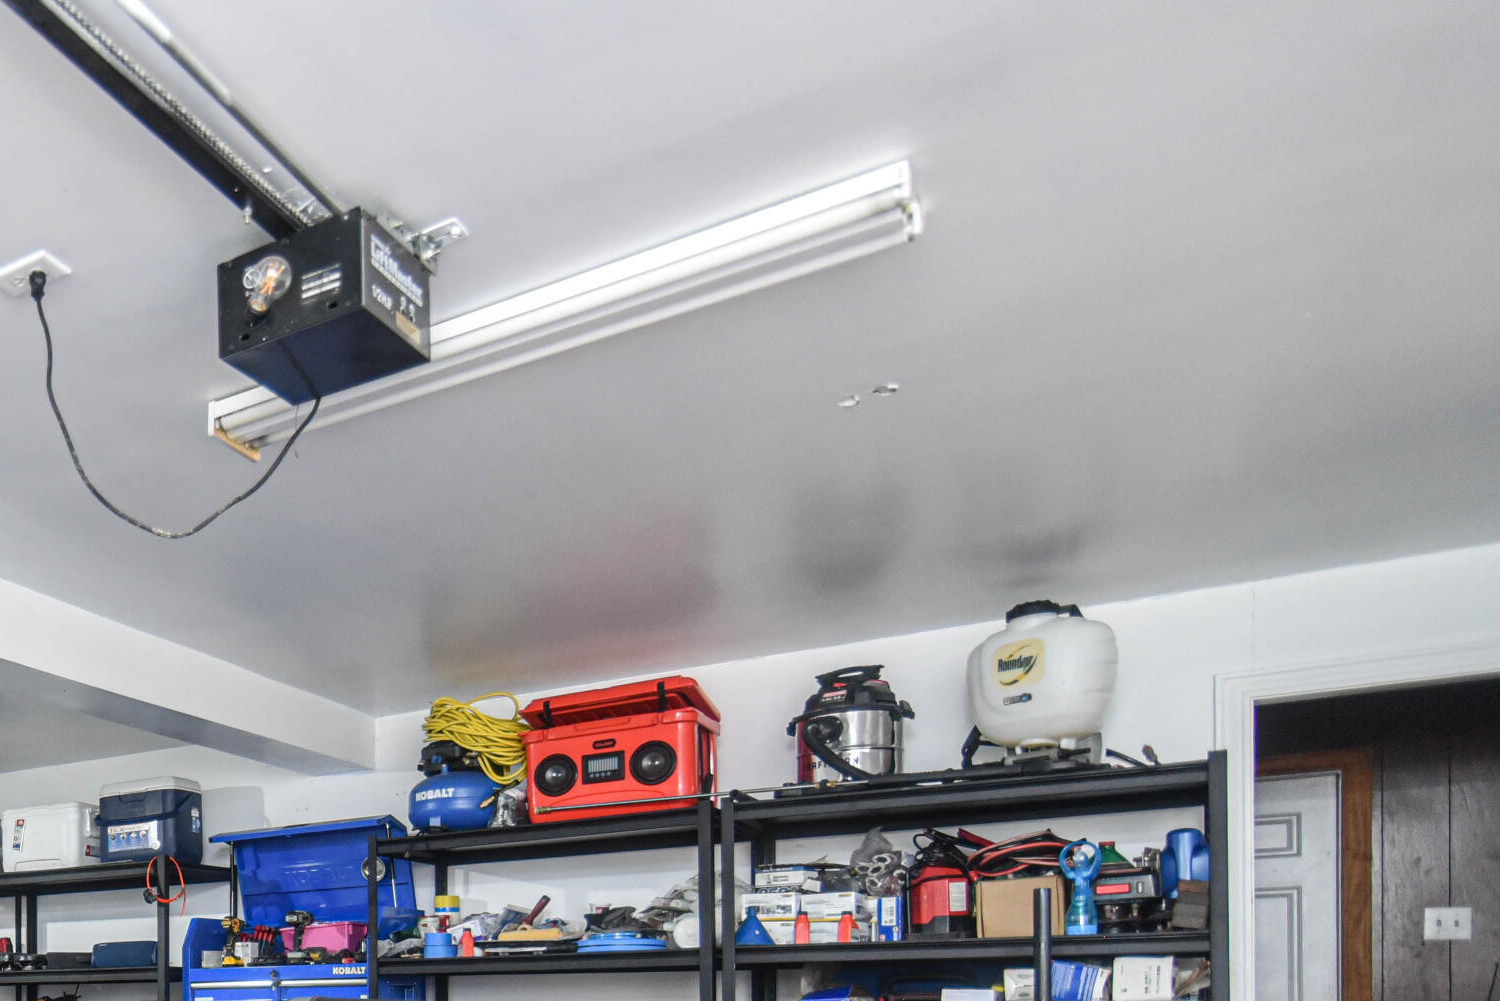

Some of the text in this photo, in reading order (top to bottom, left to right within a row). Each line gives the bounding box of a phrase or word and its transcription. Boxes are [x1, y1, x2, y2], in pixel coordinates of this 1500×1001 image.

[998, 655, 1034, 673] Roundup
[415, 788, 455, 802] KOBALT
[332, 966, 367, 975] KOBALT
